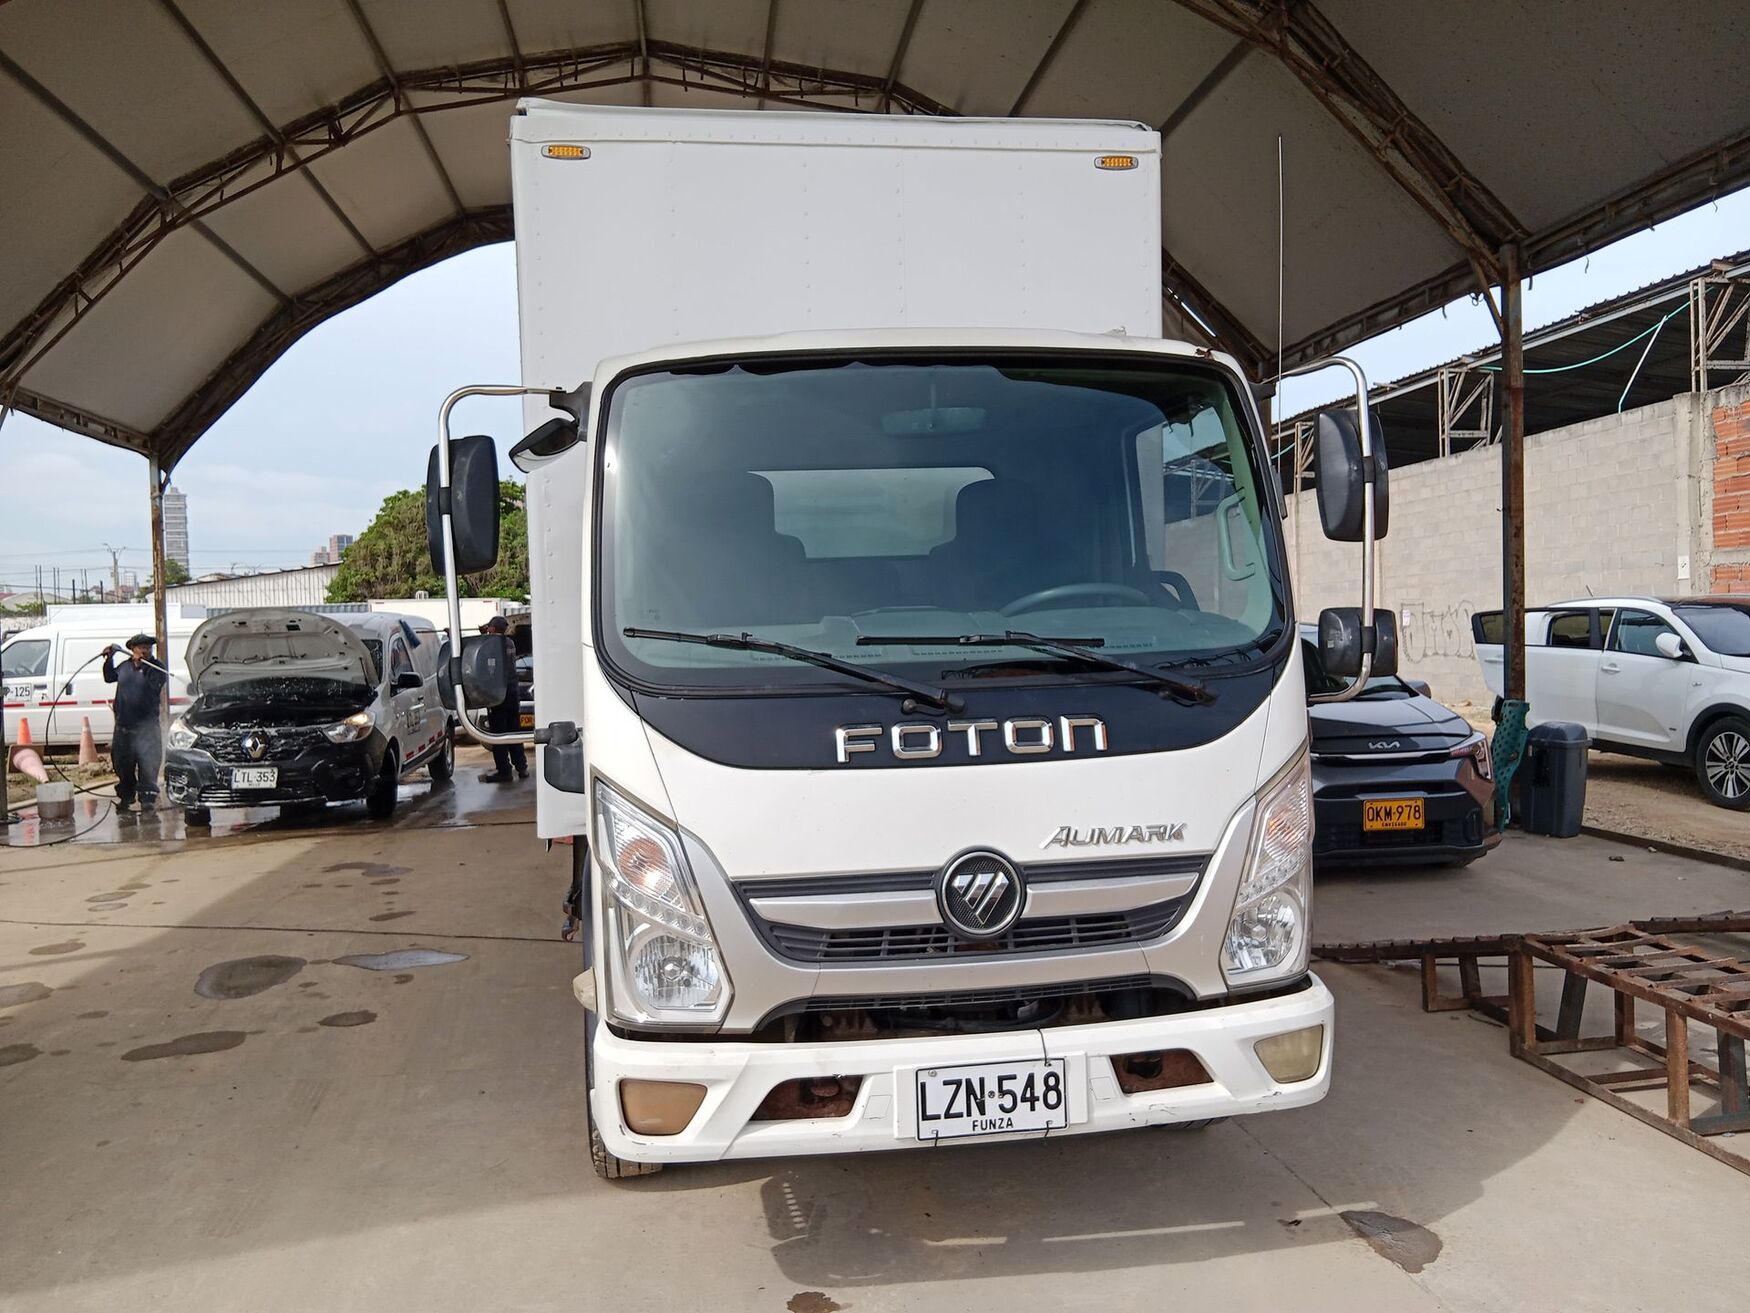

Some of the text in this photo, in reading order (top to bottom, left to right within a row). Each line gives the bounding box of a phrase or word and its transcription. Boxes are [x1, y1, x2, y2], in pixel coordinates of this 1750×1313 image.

[835, 714, 1108, 763] FOTON
[1368, 741, 1400, 749] KIA
[1039, 823, 1187, 849] AUMARK
[972, 1117, 1014, 1131] FUNZA
